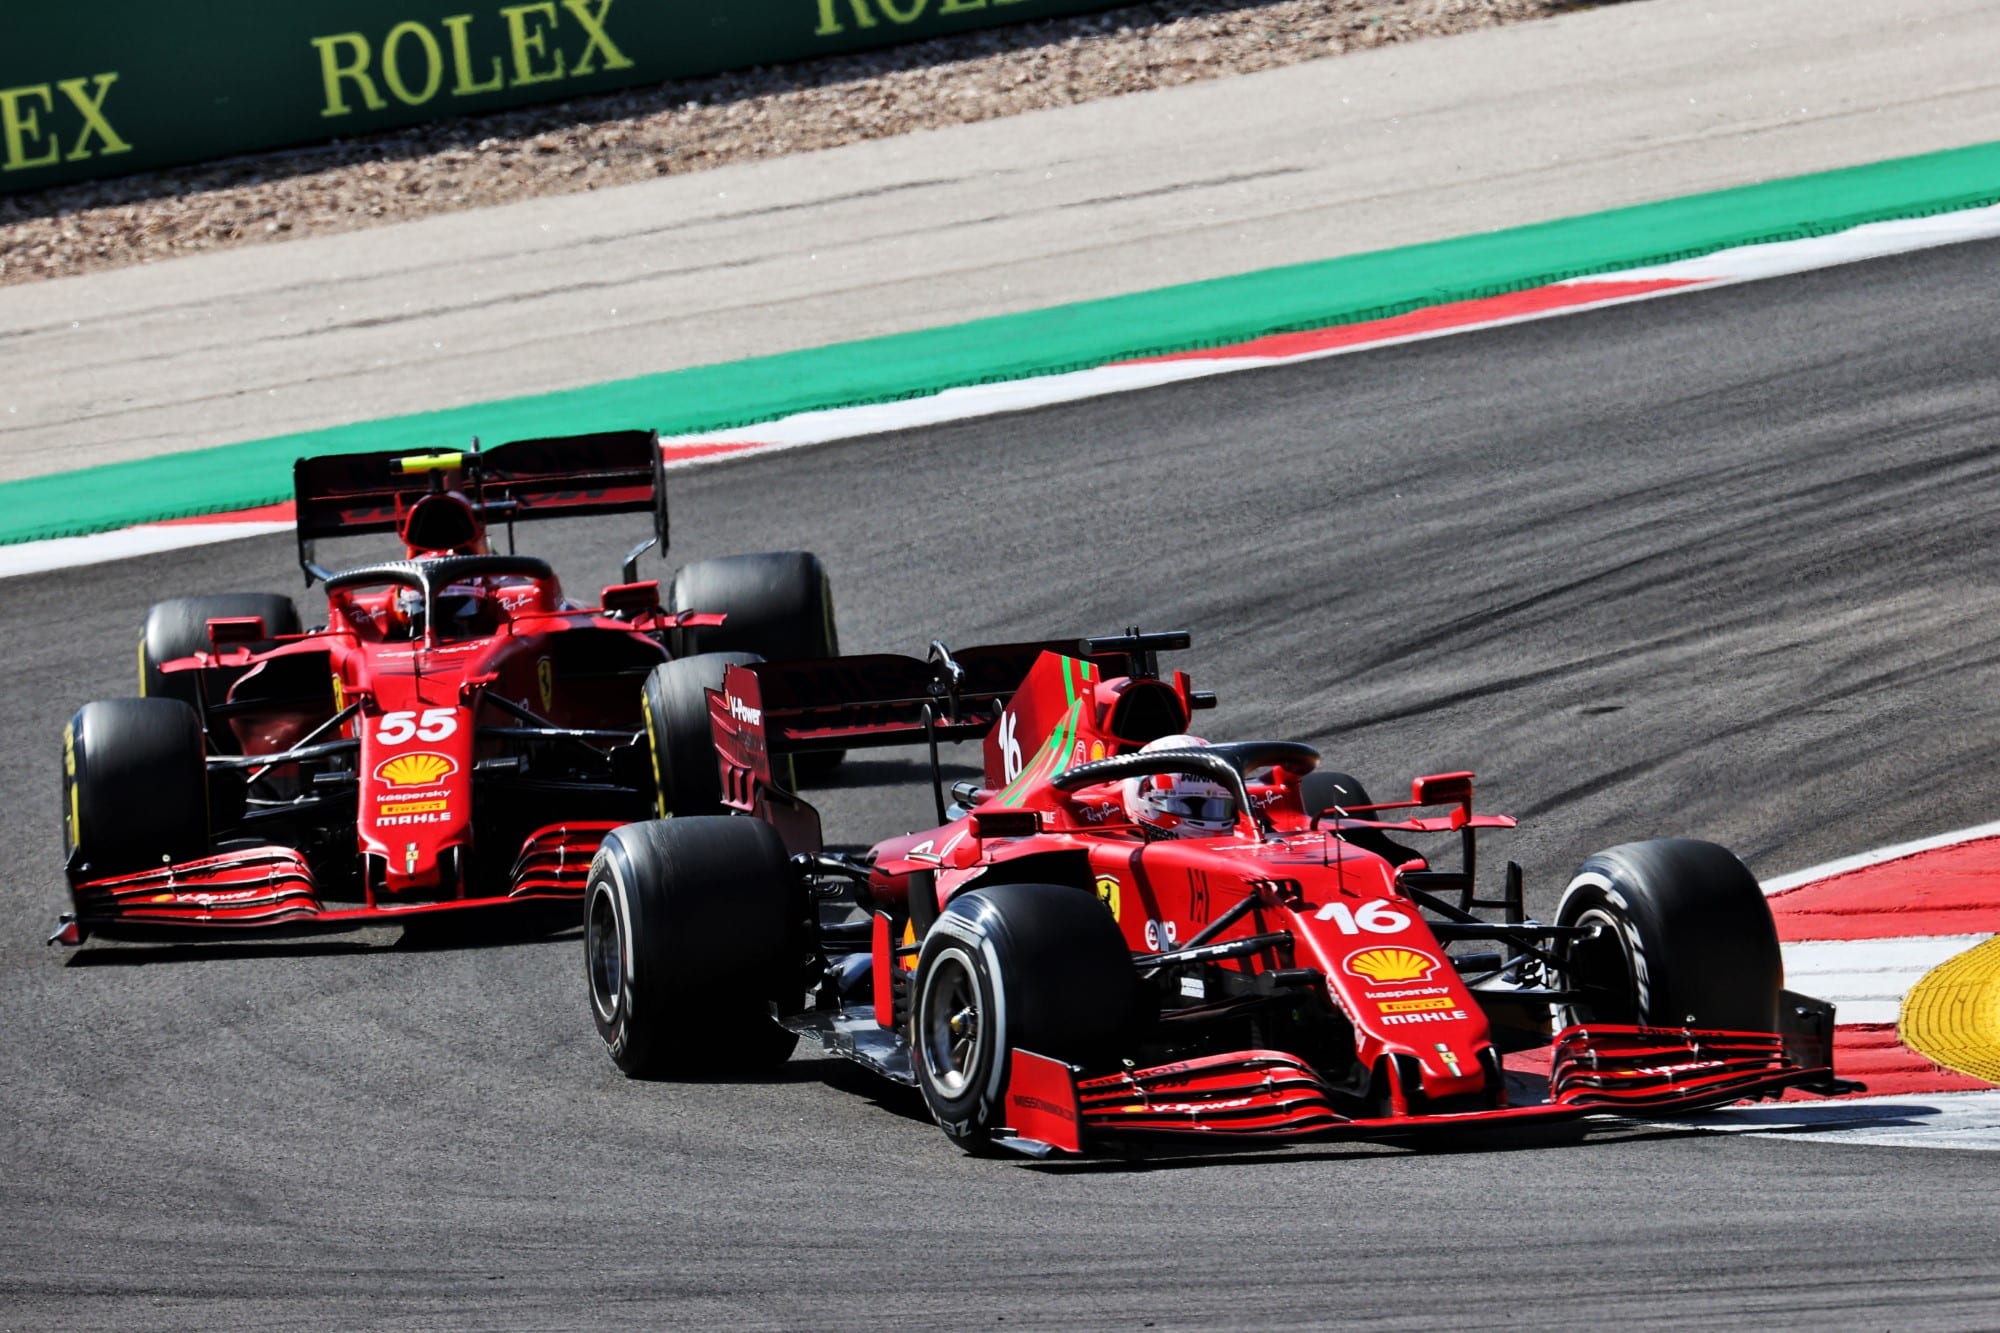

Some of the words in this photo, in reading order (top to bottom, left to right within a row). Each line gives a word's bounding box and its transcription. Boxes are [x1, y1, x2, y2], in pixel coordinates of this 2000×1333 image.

[310, 0, 635, 117] ROLEX
[729, 695, 761, 726] V-Power
[376, 707, 458, 746] 55
[998, 709, 1023, 786] 16
[376, 788, 451, 803] kaspersky
[375, 812, 452, 828] MAHLE
[1314, 898, 1412, 935] 16
[1364, 985, 1449, 1000] kaspersky
[1385, 999, 1448, 1011] PIRELLI
[1380, 1009, 1468, 1026] MAHLE
[1151, 1097, 1253, 1113] V-Power
